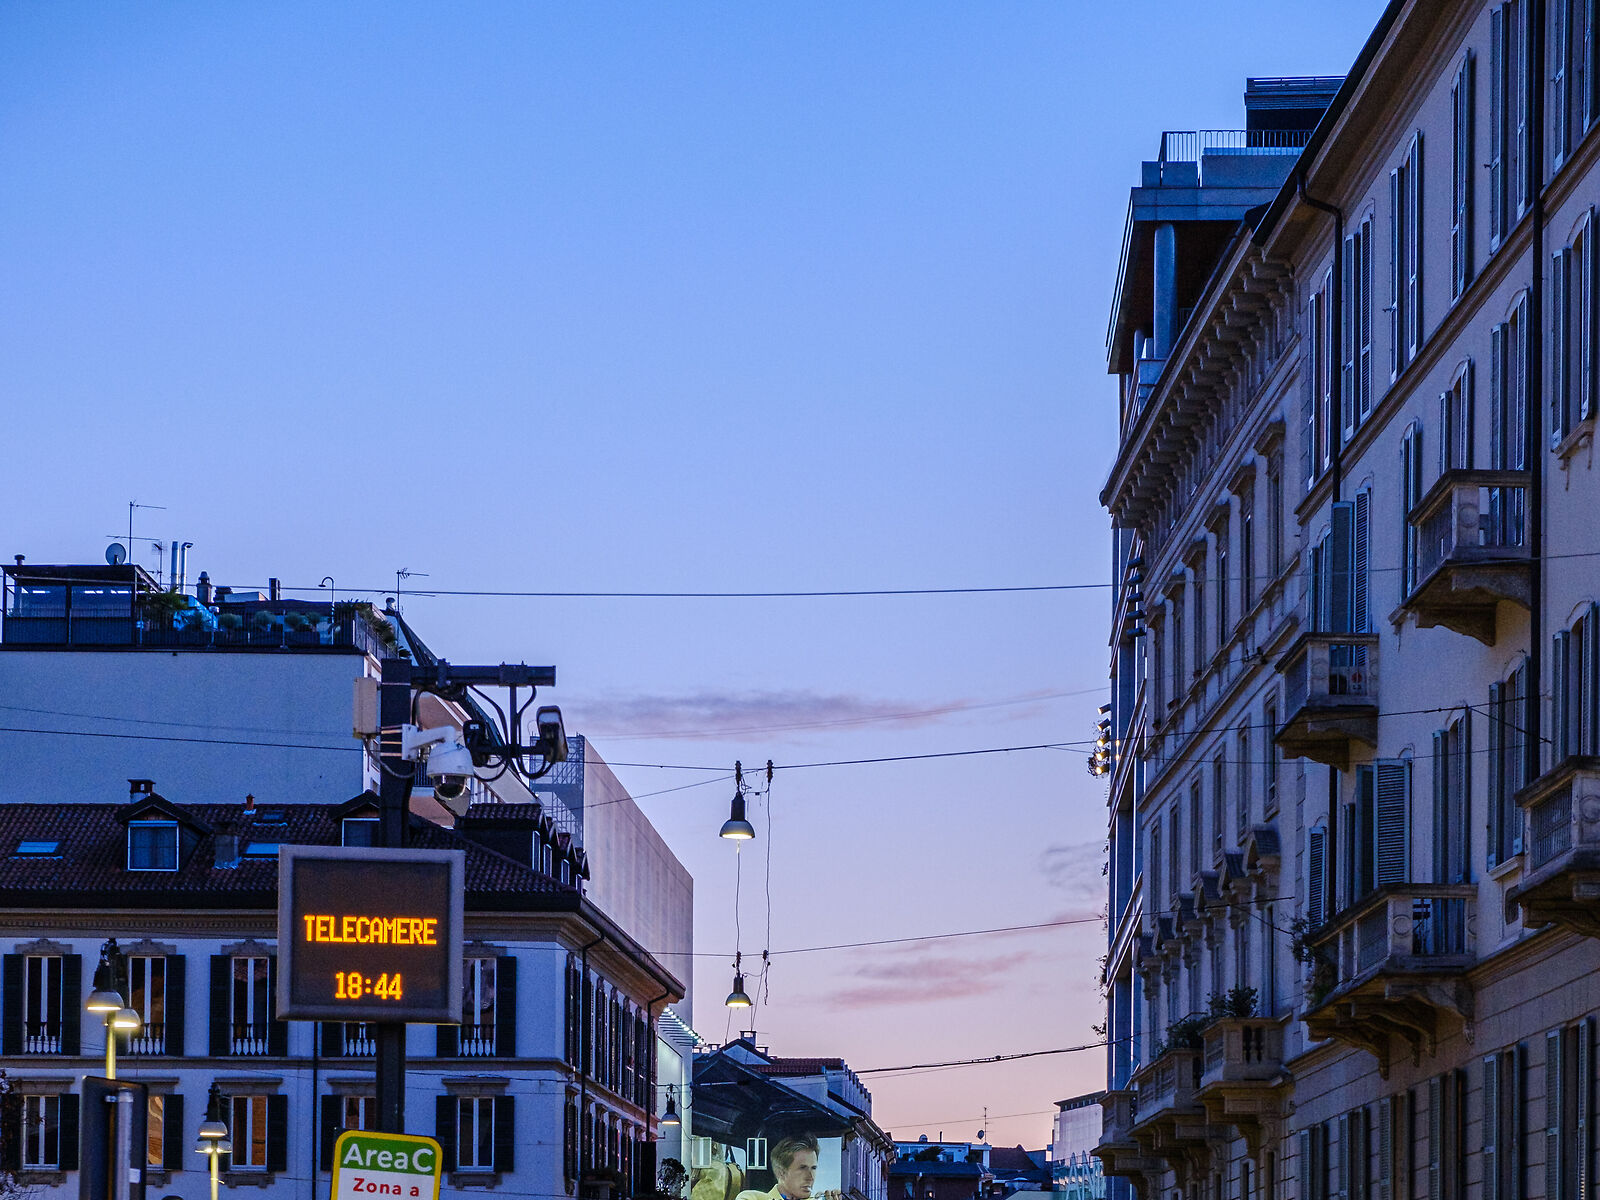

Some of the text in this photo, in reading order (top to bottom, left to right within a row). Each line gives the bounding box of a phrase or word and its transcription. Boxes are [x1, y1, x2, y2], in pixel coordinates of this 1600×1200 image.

[303, 914, 439, 945] TELECAMERE
[334, 971, 403, 1000] 18:44
[352, 1177, 420, 1197] Zona a
